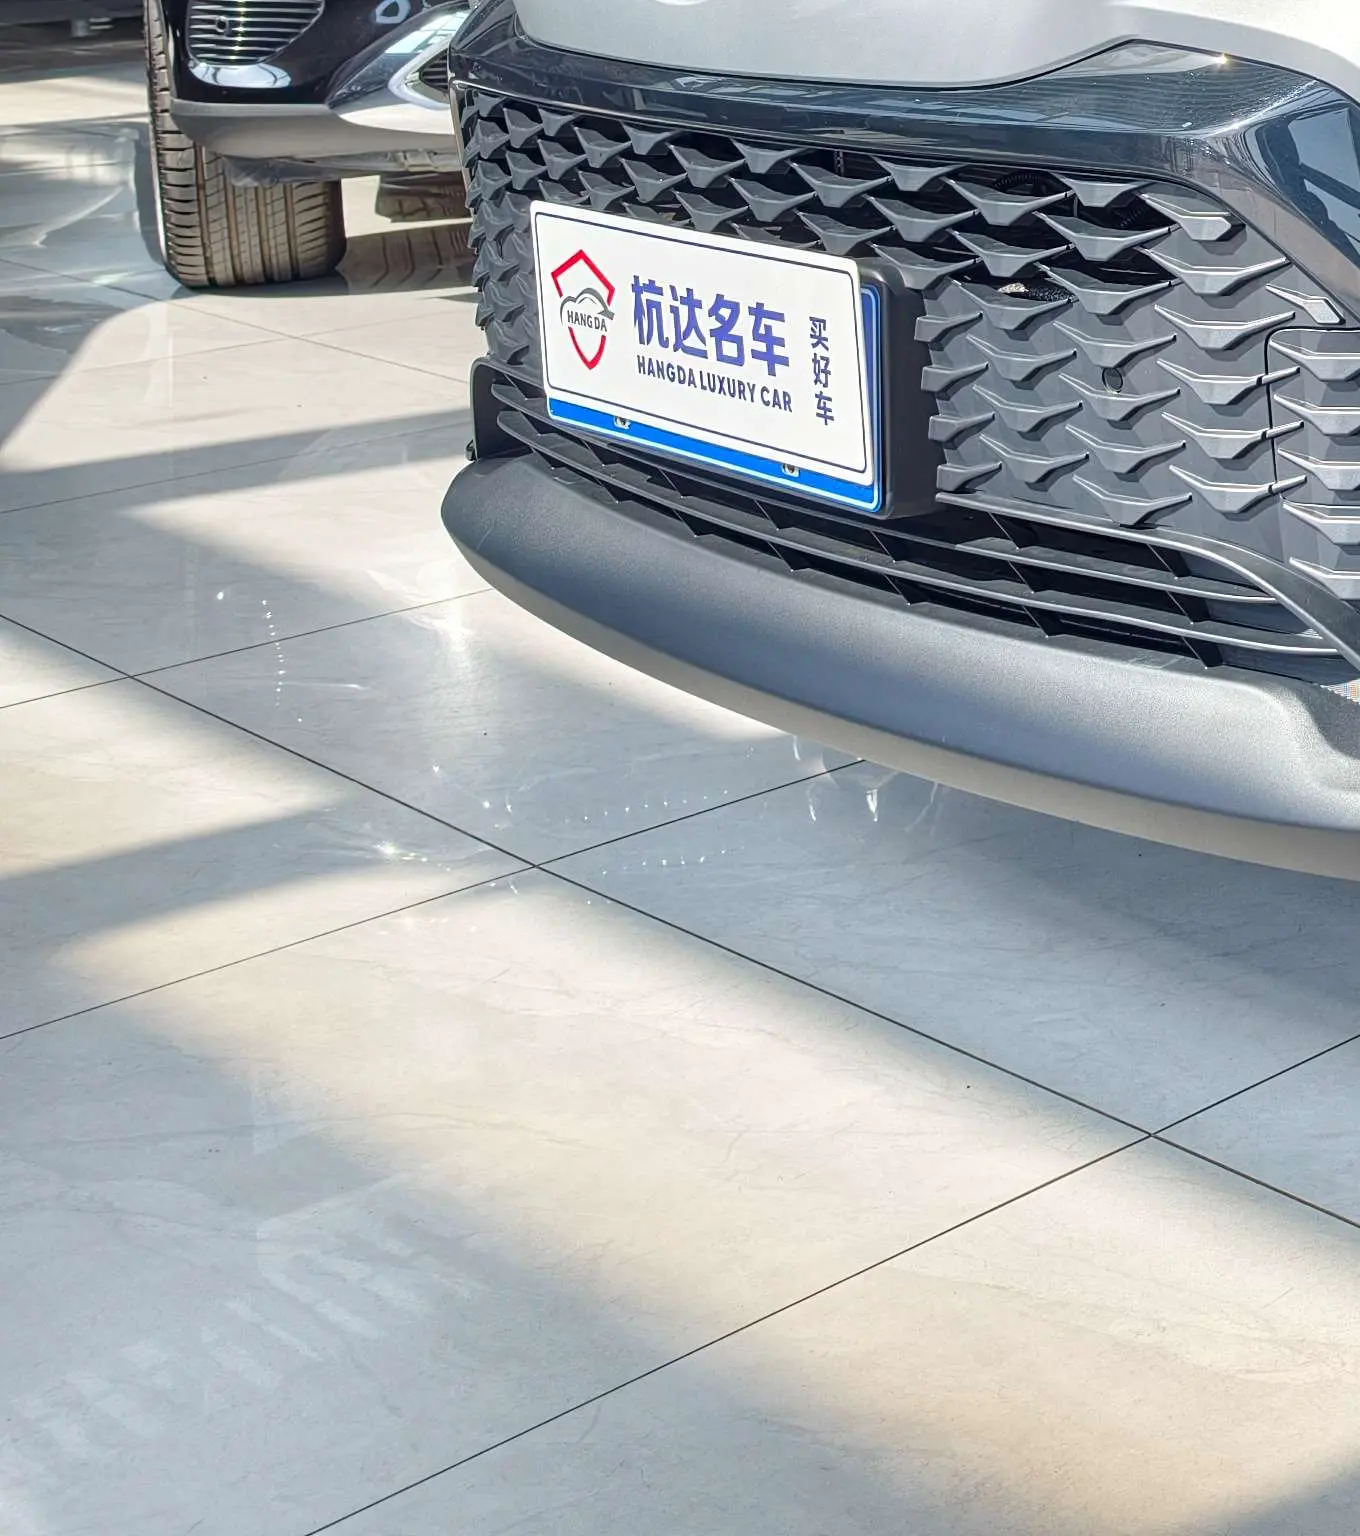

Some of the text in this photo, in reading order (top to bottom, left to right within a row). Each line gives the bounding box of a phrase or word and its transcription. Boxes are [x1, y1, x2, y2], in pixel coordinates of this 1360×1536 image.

[566, 309, 608, 333] HANG DA
[631, 274, 790, 378] 杭达名车
[636, 354, 793, 413] HANGDA LUXURY CAR
[808, 315, 835, 426] 买好车
